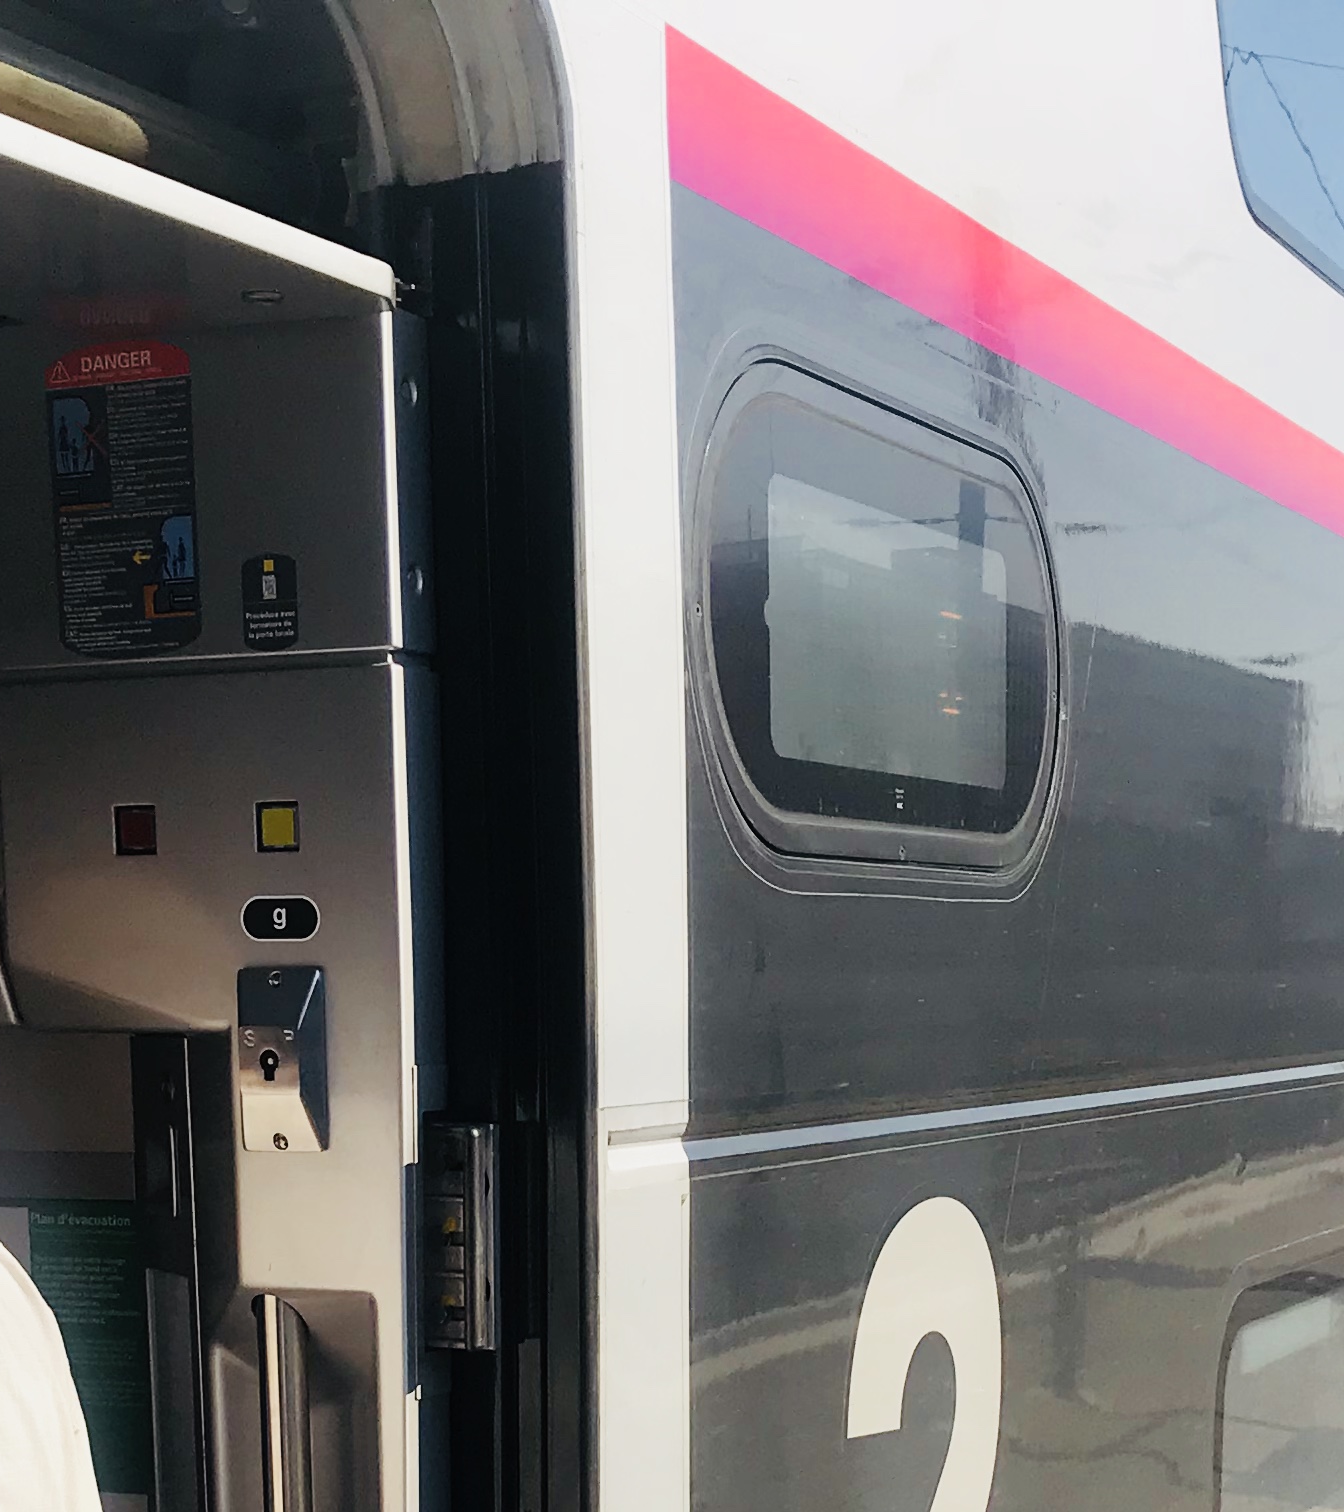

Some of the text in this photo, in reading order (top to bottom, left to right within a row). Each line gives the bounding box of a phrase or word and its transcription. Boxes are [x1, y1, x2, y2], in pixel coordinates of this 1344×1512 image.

[80, 349, 152, 373] DANGER
[272, 907, 287, 930] g
[30, 1212, 131, 1226] Plan d'évacuation
